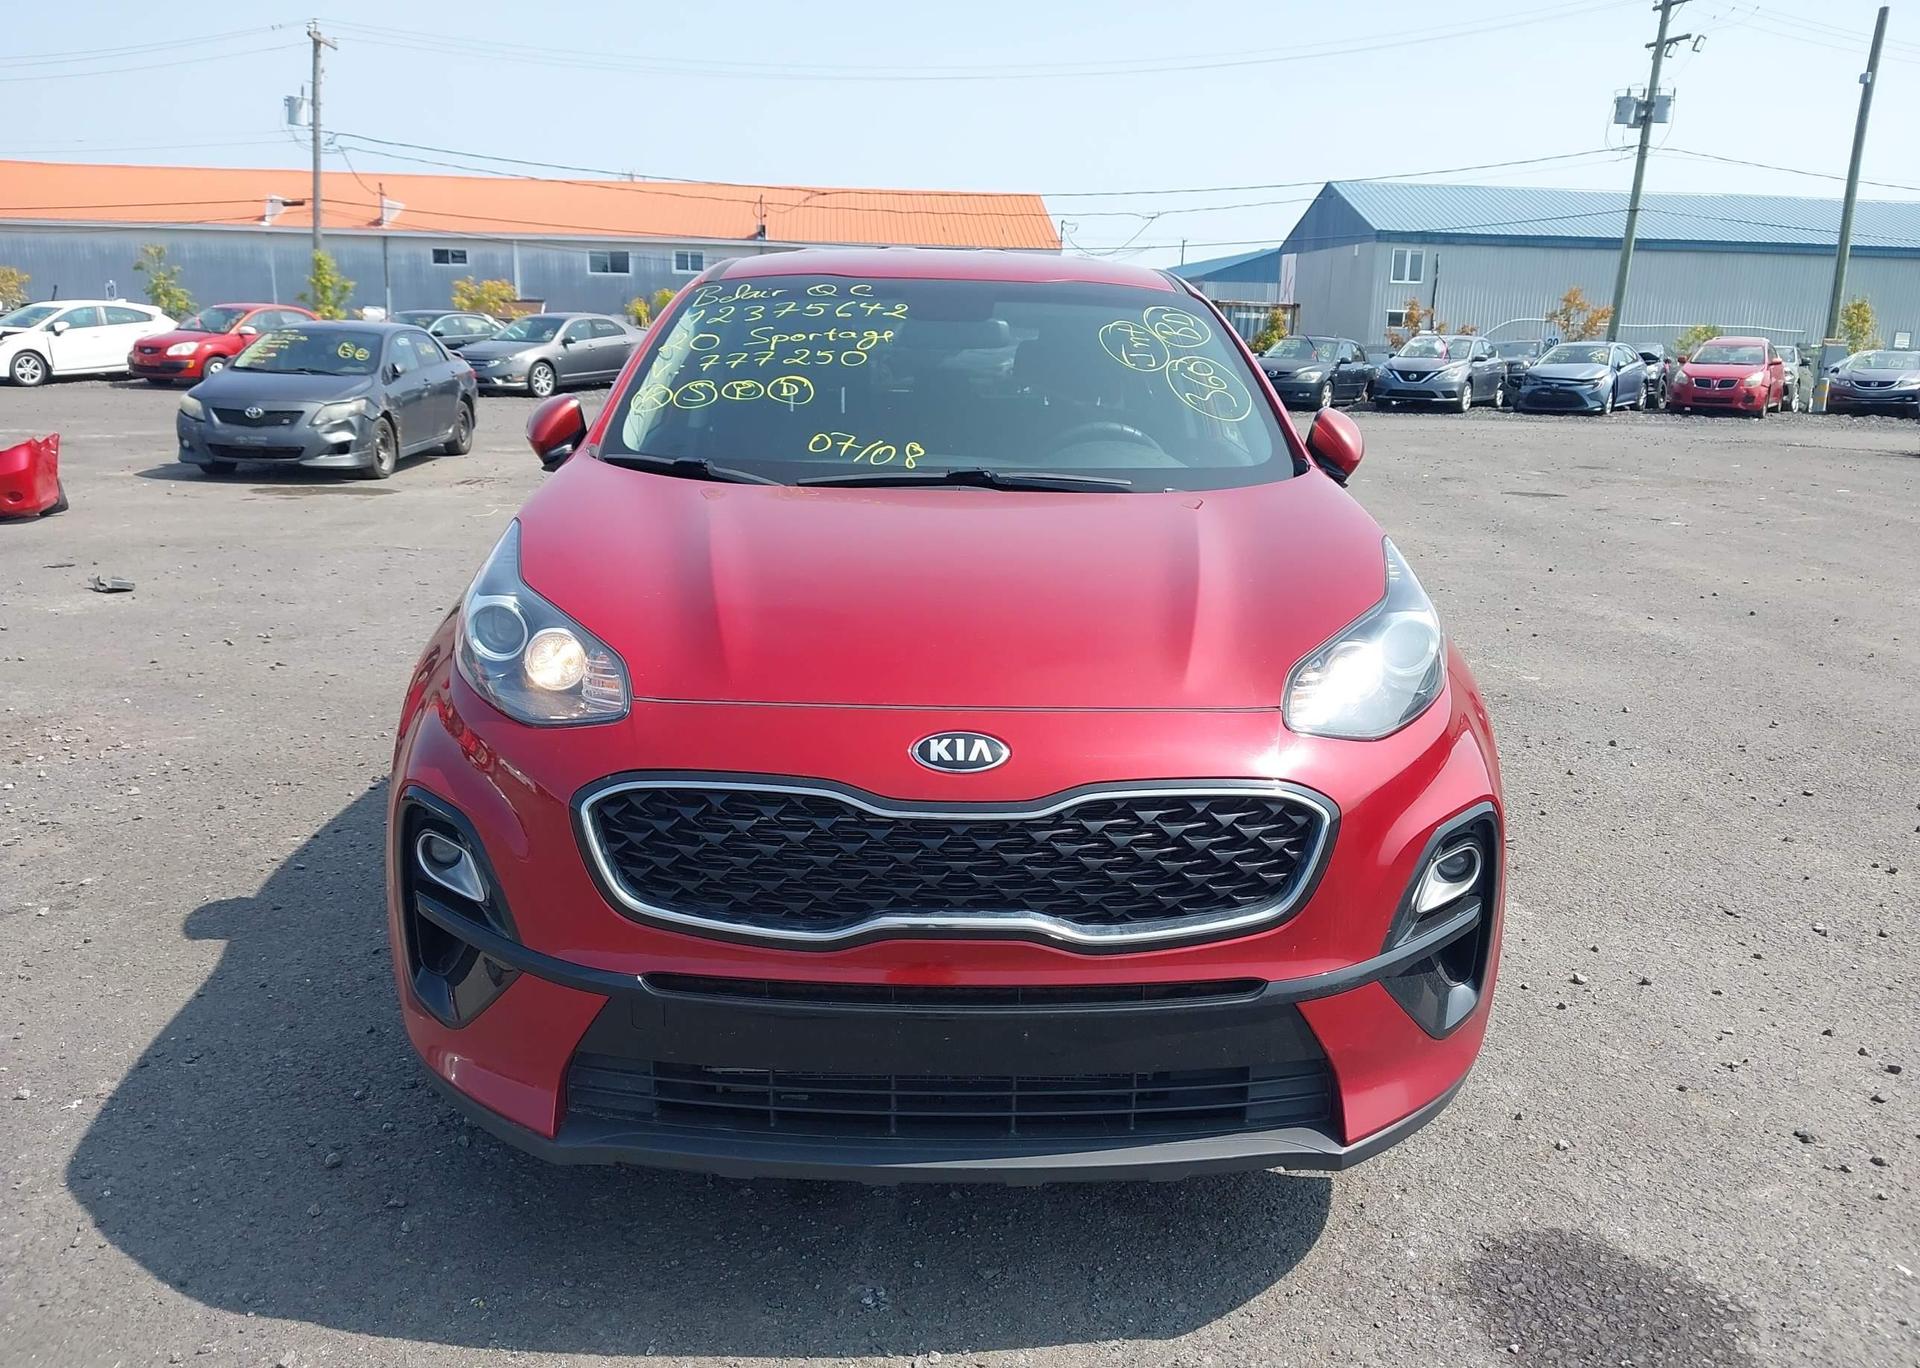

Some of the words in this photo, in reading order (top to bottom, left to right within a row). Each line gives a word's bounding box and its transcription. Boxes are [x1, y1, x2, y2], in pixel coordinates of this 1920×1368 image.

[743, 327, 895, 350] Sportage
[808, 432, 925, 469] 07/08
[928, 738, 994, 762] KIA
